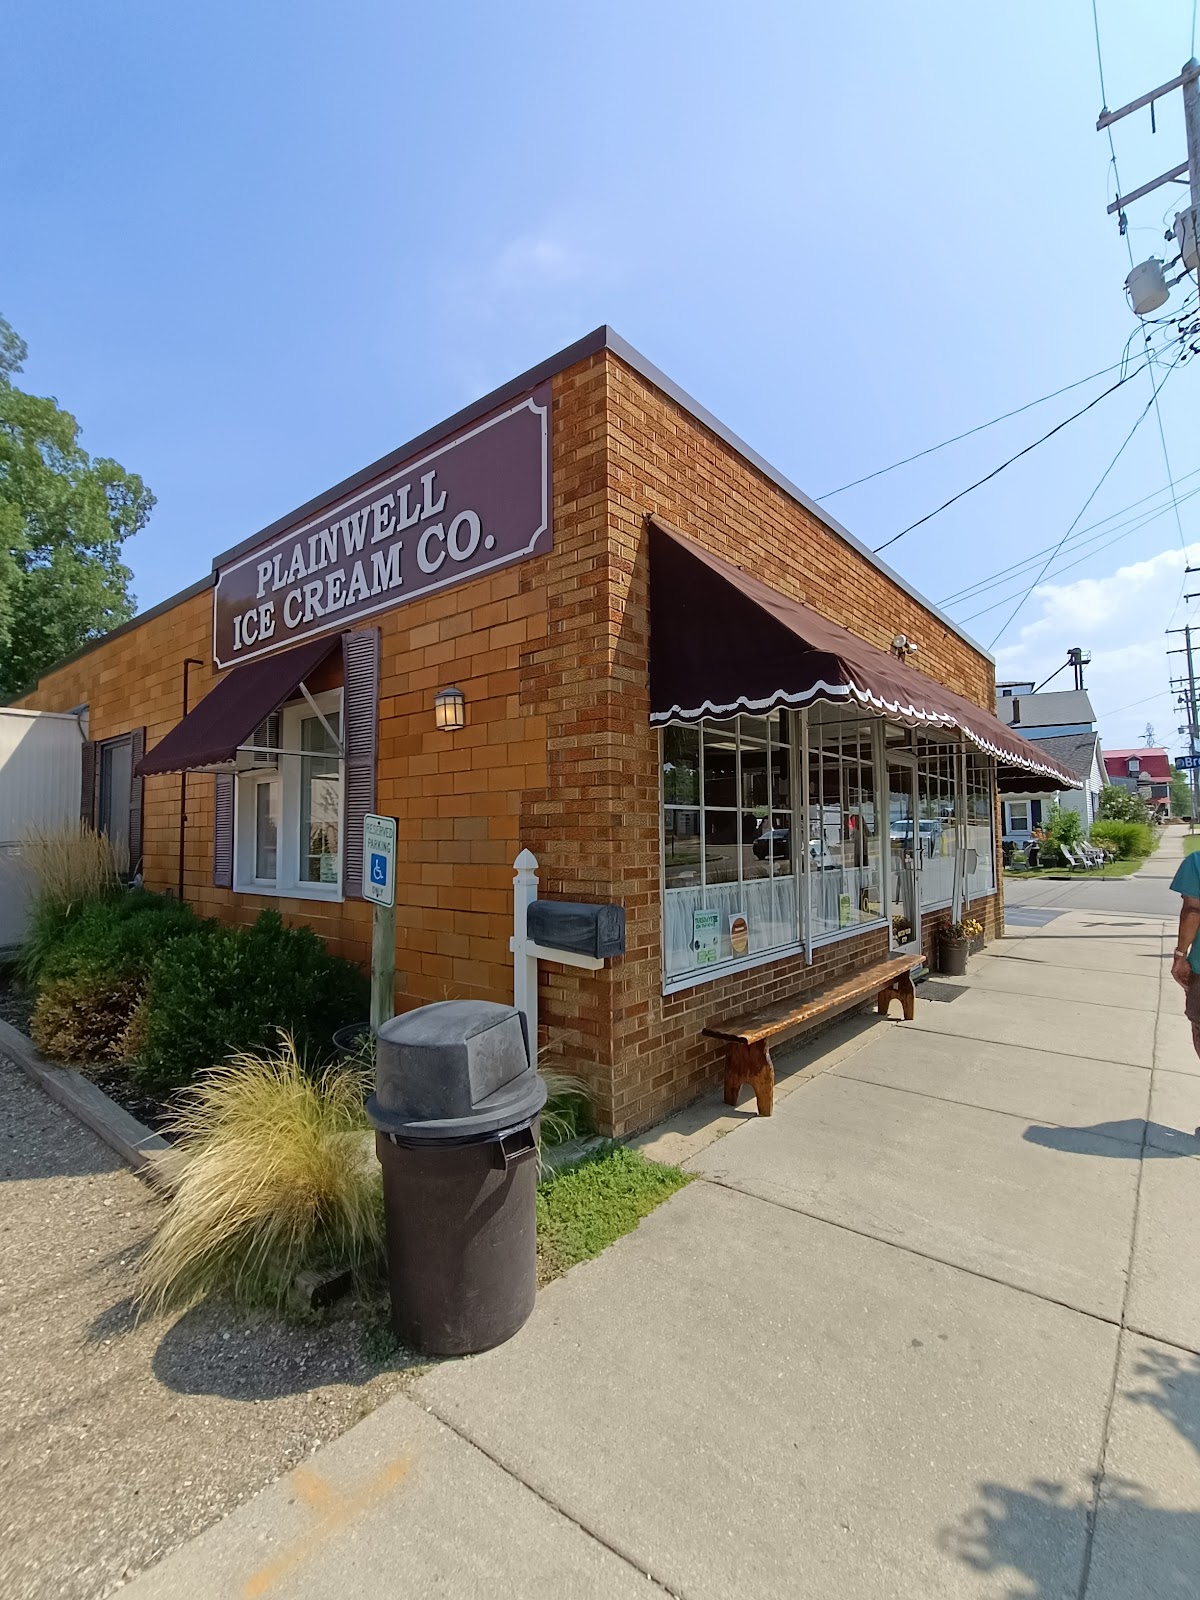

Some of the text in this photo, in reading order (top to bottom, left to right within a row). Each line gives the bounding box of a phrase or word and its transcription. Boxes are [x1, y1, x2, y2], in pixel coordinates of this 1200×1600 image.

[256, 470, 447, 599] PLAINWELL
[233, 509, 495, 651] ICE CREAM CO.
[366, 823, 392, 838] RESERVED
[367, 838, 391, 853] PARKING
